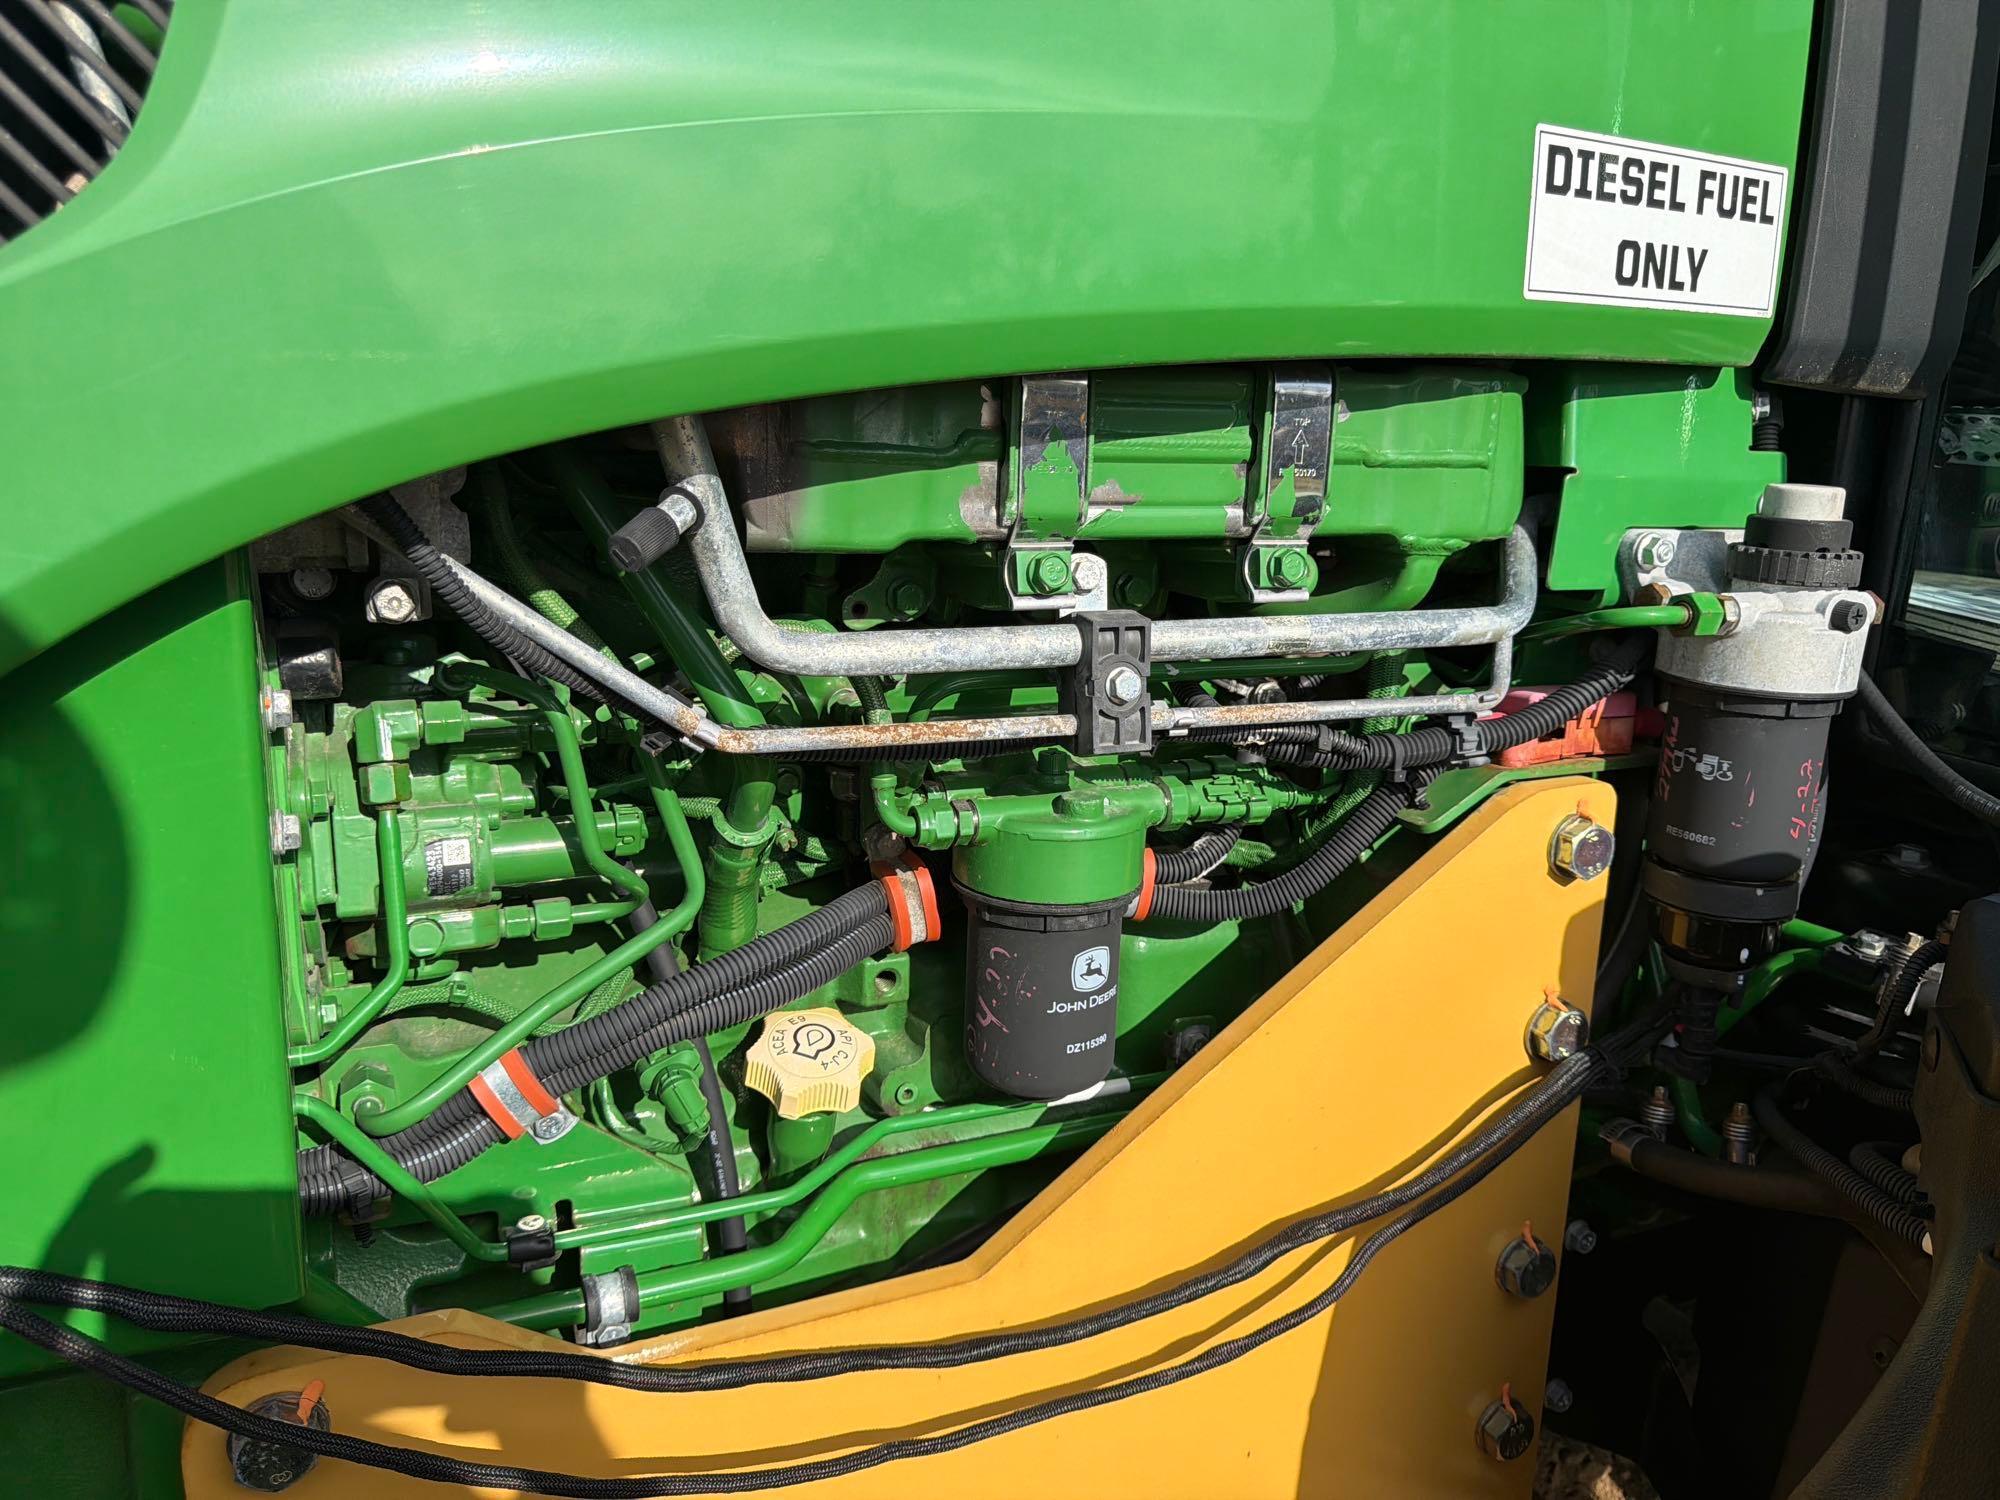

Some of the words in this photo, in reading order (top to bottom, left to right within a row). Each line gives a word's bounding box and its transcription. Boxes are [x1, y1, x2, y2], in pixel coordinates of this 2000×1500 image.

[1545, 144, 1686, 213] DIESEL
[1696, 169, 1775, 226] FUEL
[1615, 239, 1709, 293] ONLY
[1665, 824, 1717, 847] RE560682
[1046, 1000, 1087, 1014] JOHN
[1089, 984, 1118, 1008] DEERE
[773, 1029, 788, 1056] ACEA
[787, 1015, 806, 1026] E9
[836, 1029, 853, 1046] API
[1066, 1033, 1107, 1054] DZ115390
[820, 1049, 849, 1071] CJ-4
